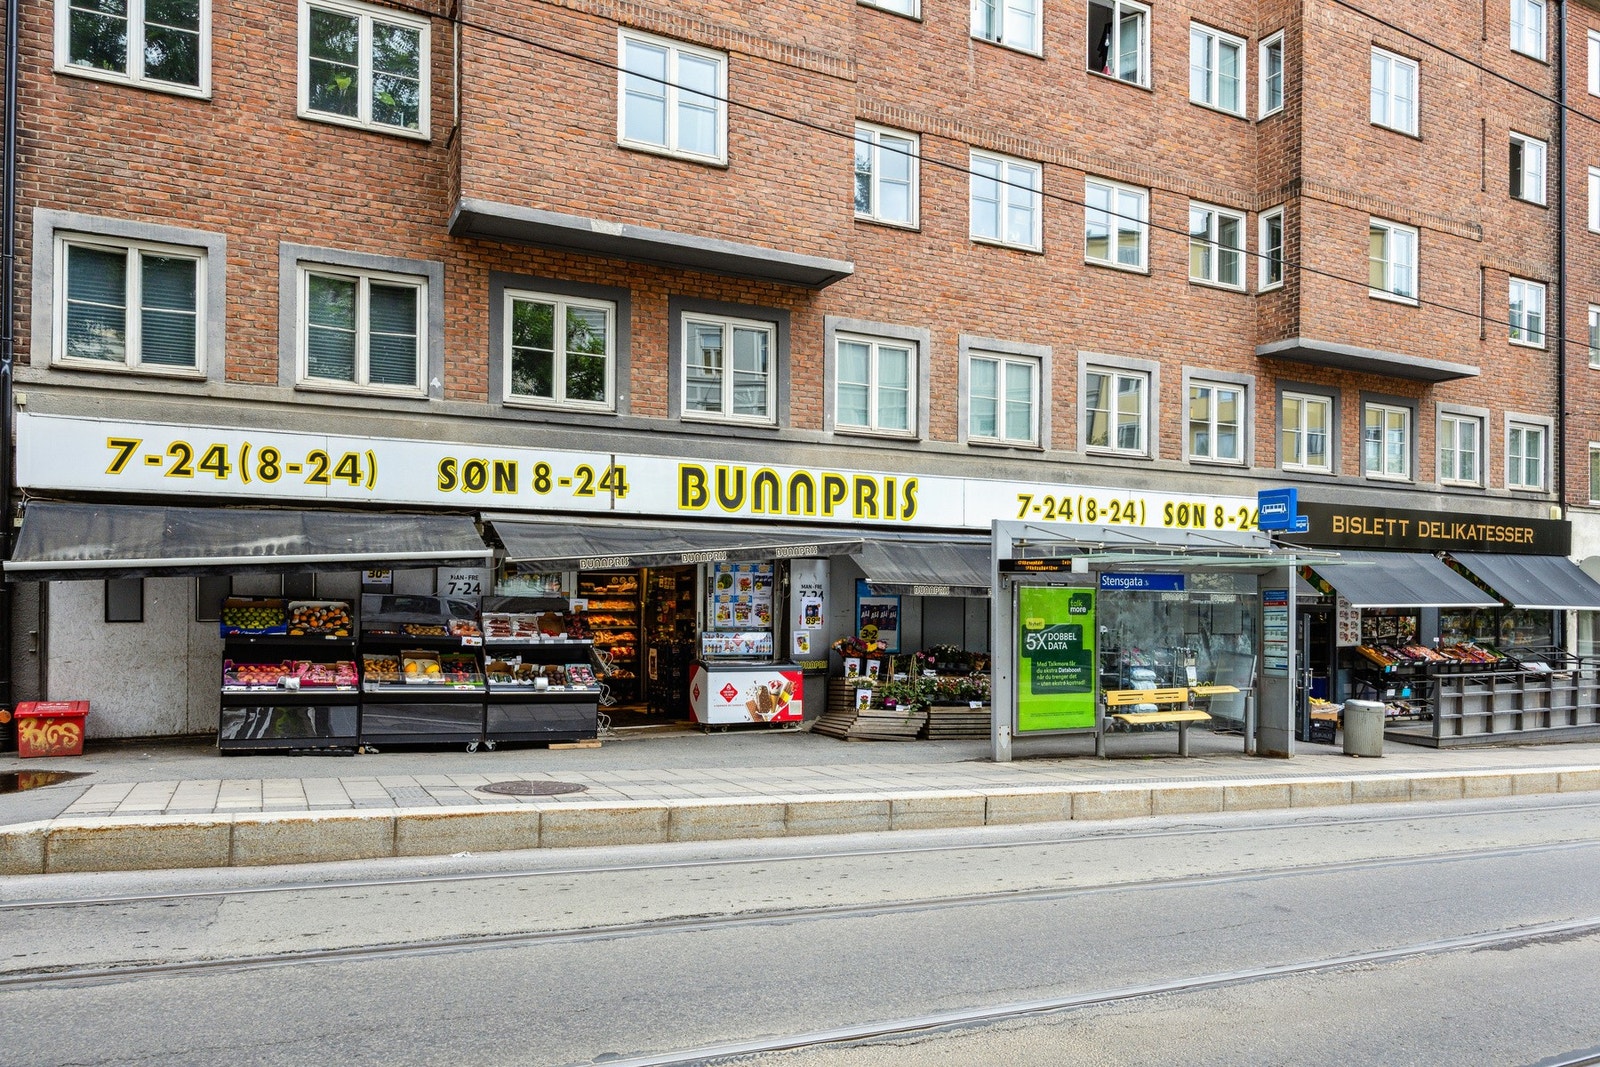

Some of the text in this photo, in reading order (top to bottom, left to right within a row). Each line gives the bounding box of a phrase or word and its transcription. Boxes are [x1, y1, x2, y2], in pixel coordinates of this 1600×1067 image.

[438, 457, 630, 498] SØN 8-24
[678, 463, 919, 521] BUNNPRIS
[1164, 502, 1207, 528] SØN
[1332, 515, 1534, 544] BISLETT DELIKATESSER
[682, 551, 727, 563] BUNNPRIS
[776, 546, 818, 558] BUNNPRIS
[580, 557, 629, 569] BUNNPRIS
[1102, 575, 1143, 588] Stensgata
[448, 582, 481, 595] 7-24
[1026, 633, 1047, 650] 5X
[1048, 642, 1068, 650] DATA
